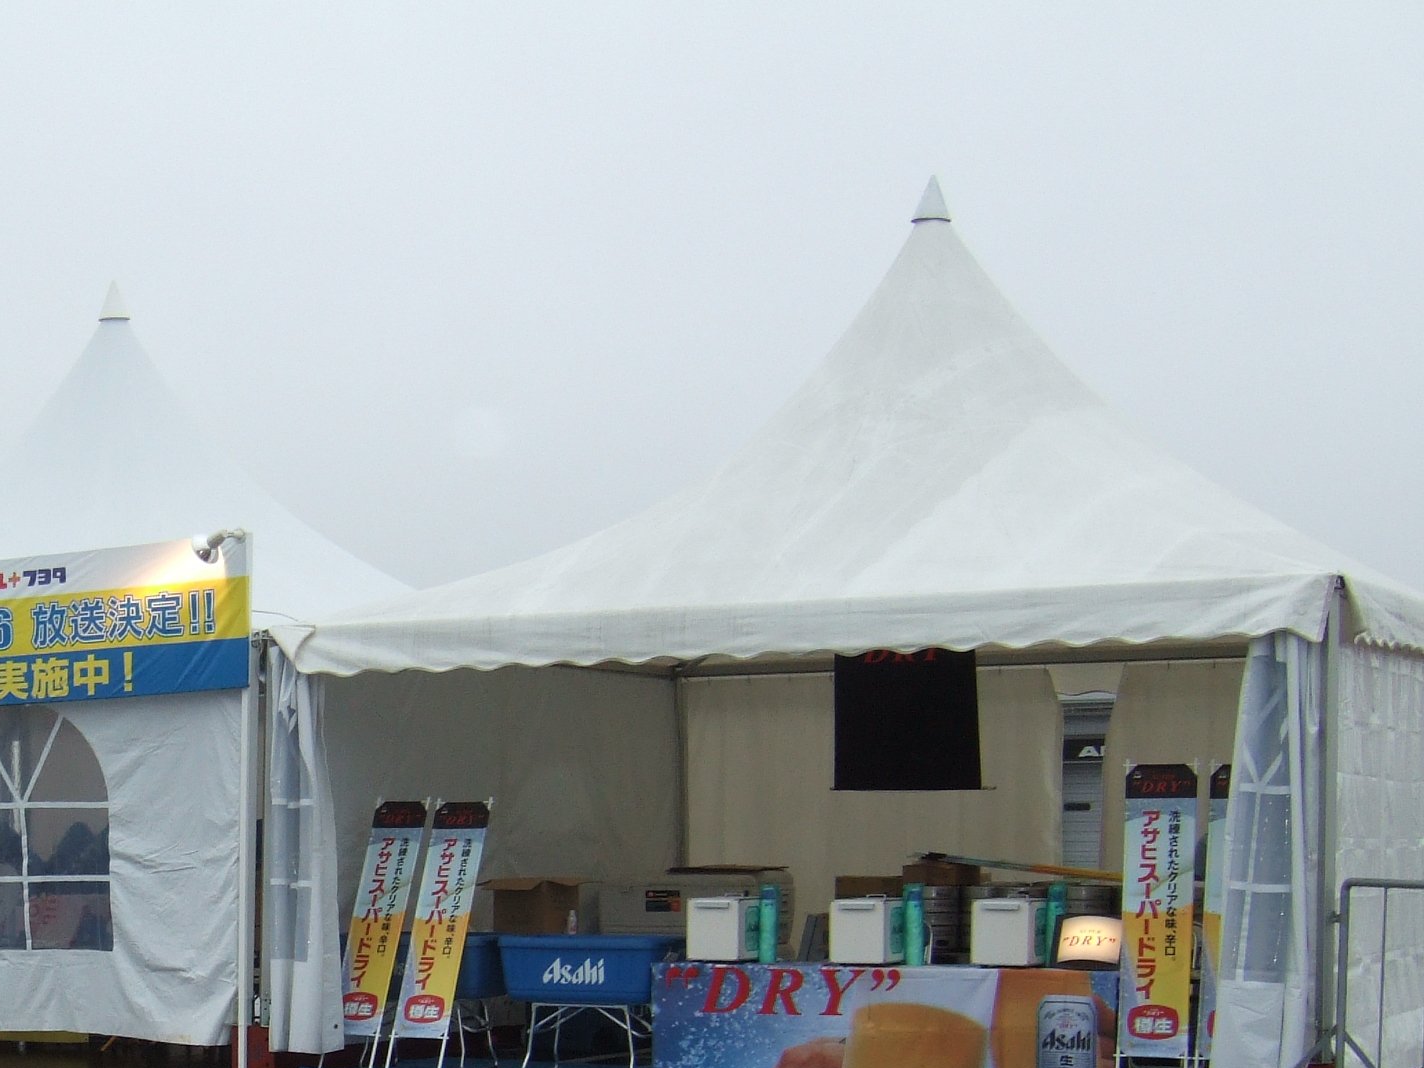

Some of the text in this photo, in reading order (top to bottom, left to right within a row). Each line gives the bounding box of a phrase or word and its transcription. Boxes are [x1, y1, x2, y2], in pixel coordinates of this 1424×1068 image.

[350, 837, 397, 988] アサヒスーパードライ
[415, 838, 459, 991] アサヒスーパードライ
[542, 957, 605, 985] Asahi
[1135, 809, 1162, 1000] アサヒスーパードライ
[1041, 1028, 1092, 1052] Asahi
